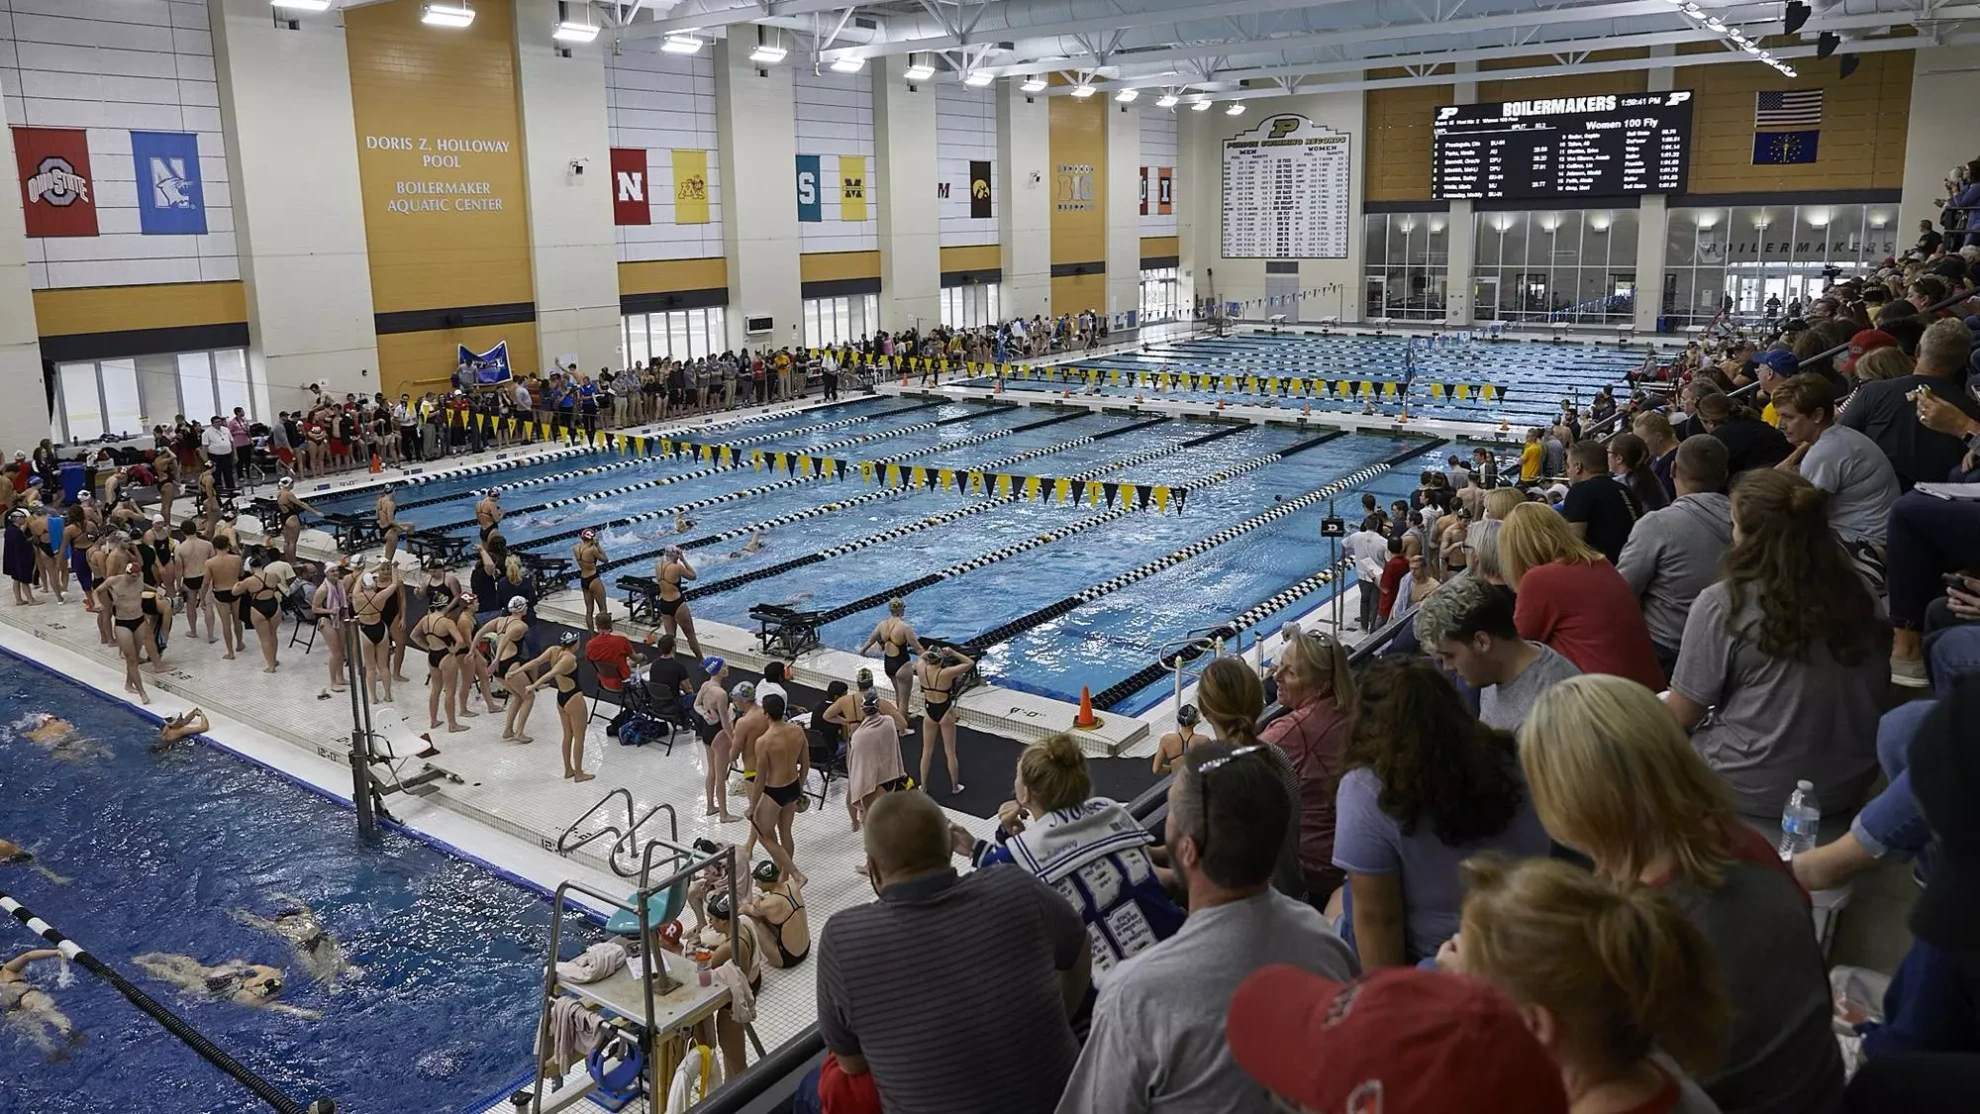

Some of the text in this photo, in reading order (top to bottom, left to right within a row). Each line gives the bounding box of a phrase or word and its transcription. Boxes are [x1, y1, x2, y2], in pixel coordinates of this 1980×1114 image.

[1503, 95, 1617, 117] BOILERMAKERS
[1648, 96, 1662, 105] PM
[1268, 118, 1300, 139] P
[1586, 117, 1659, 130] Women 100 Fly
[365, 136, 510, 153] DORIS Z. HOLLOWAY
[423, 155, 461, 168] POOL
[49, 168, 89, 203] STATE
[396, 182, 491, 195] BOILERMAKER
[617, 171, 643, 201] N
[798, 171, 816, 205] S
[937, 182, 951, 199] M
[387, 198, 503, 214] AQUATIC CENTER
[1707, 241, 1893, 254] BOILERMAKERS
[755, 453, 760, 463] 4
[864, 466, 870, 475] 3
[973, 476, 979, 486] 2
[665, 923, 678, 938] R
